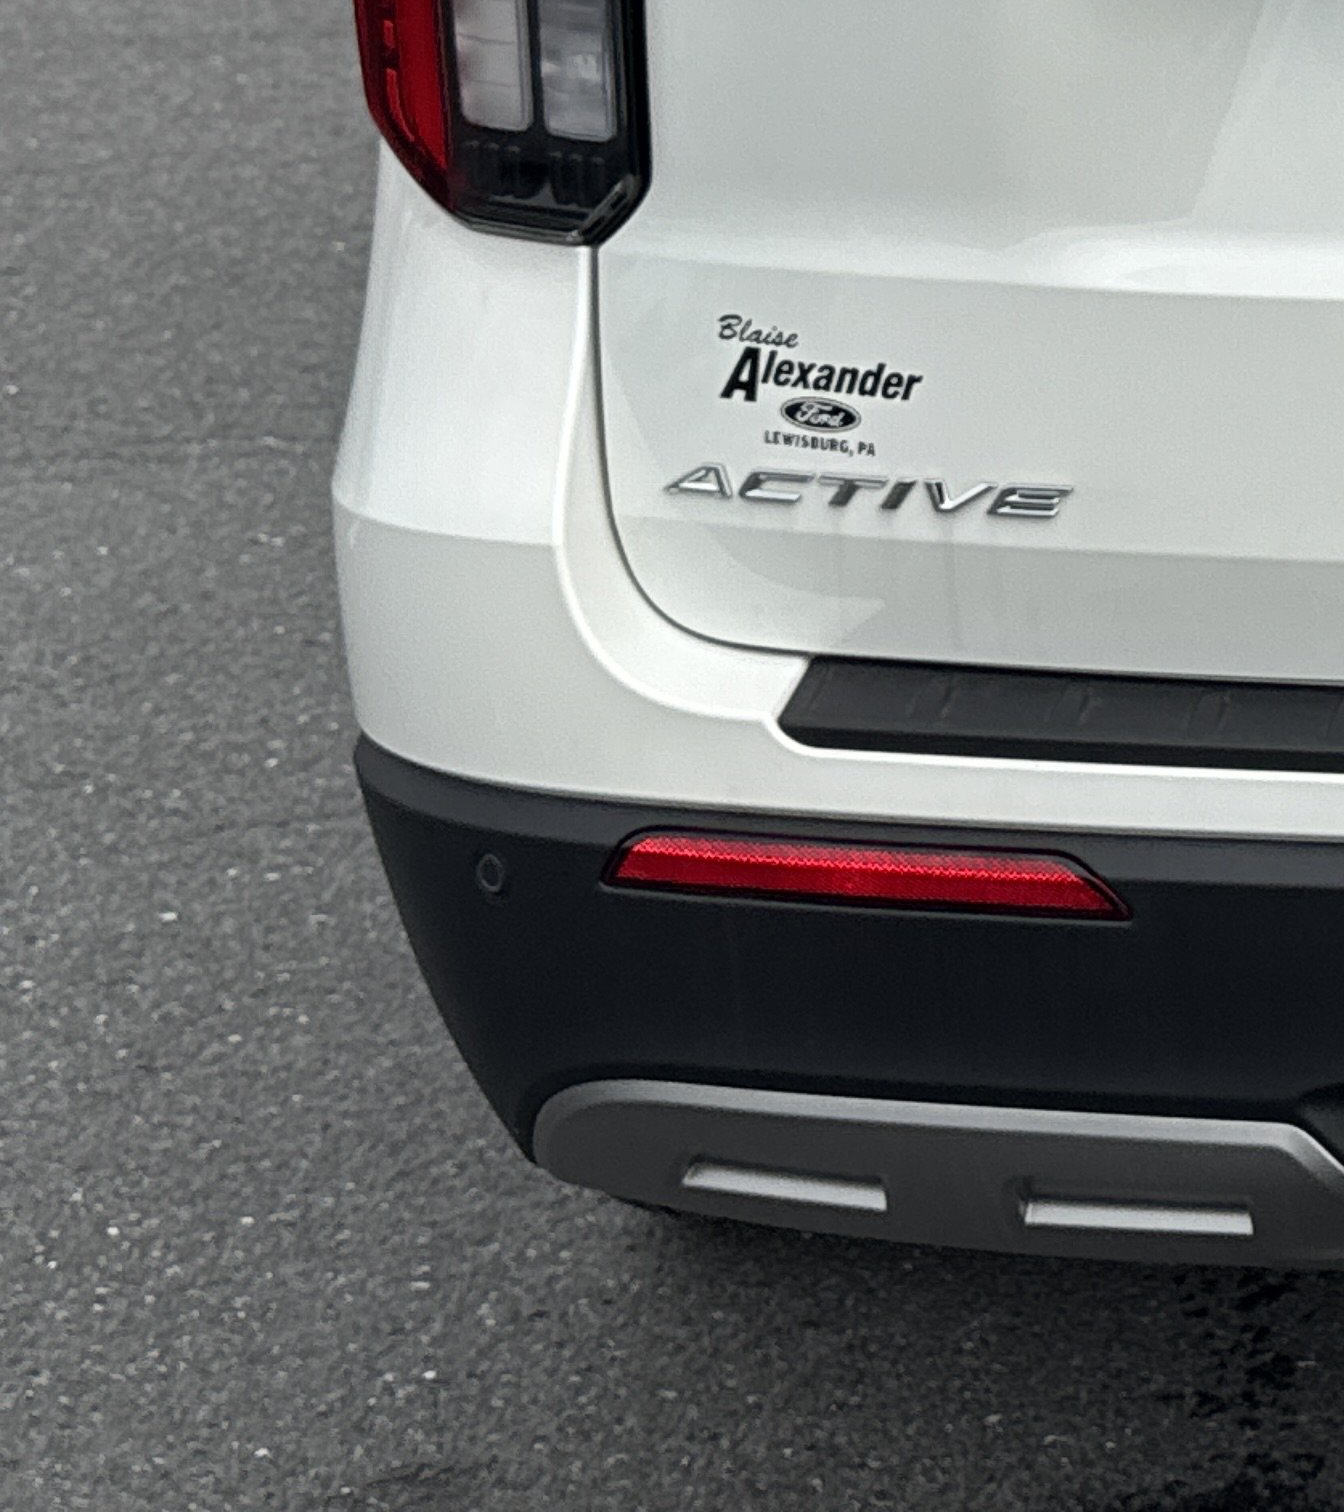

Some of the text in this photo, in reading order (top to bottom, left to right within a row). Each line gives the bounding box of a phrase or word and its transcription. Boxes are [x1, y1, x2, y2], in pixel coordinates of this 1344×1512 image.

[718, 314, 799, 348] Blaise
[719, 346, 924, 402] Alexander
[794, 401, 846, 428] Ford
[764, 430, 876, 457] LEWISBURG, PA
[663, 461, 1074, 519] ACTIVE
